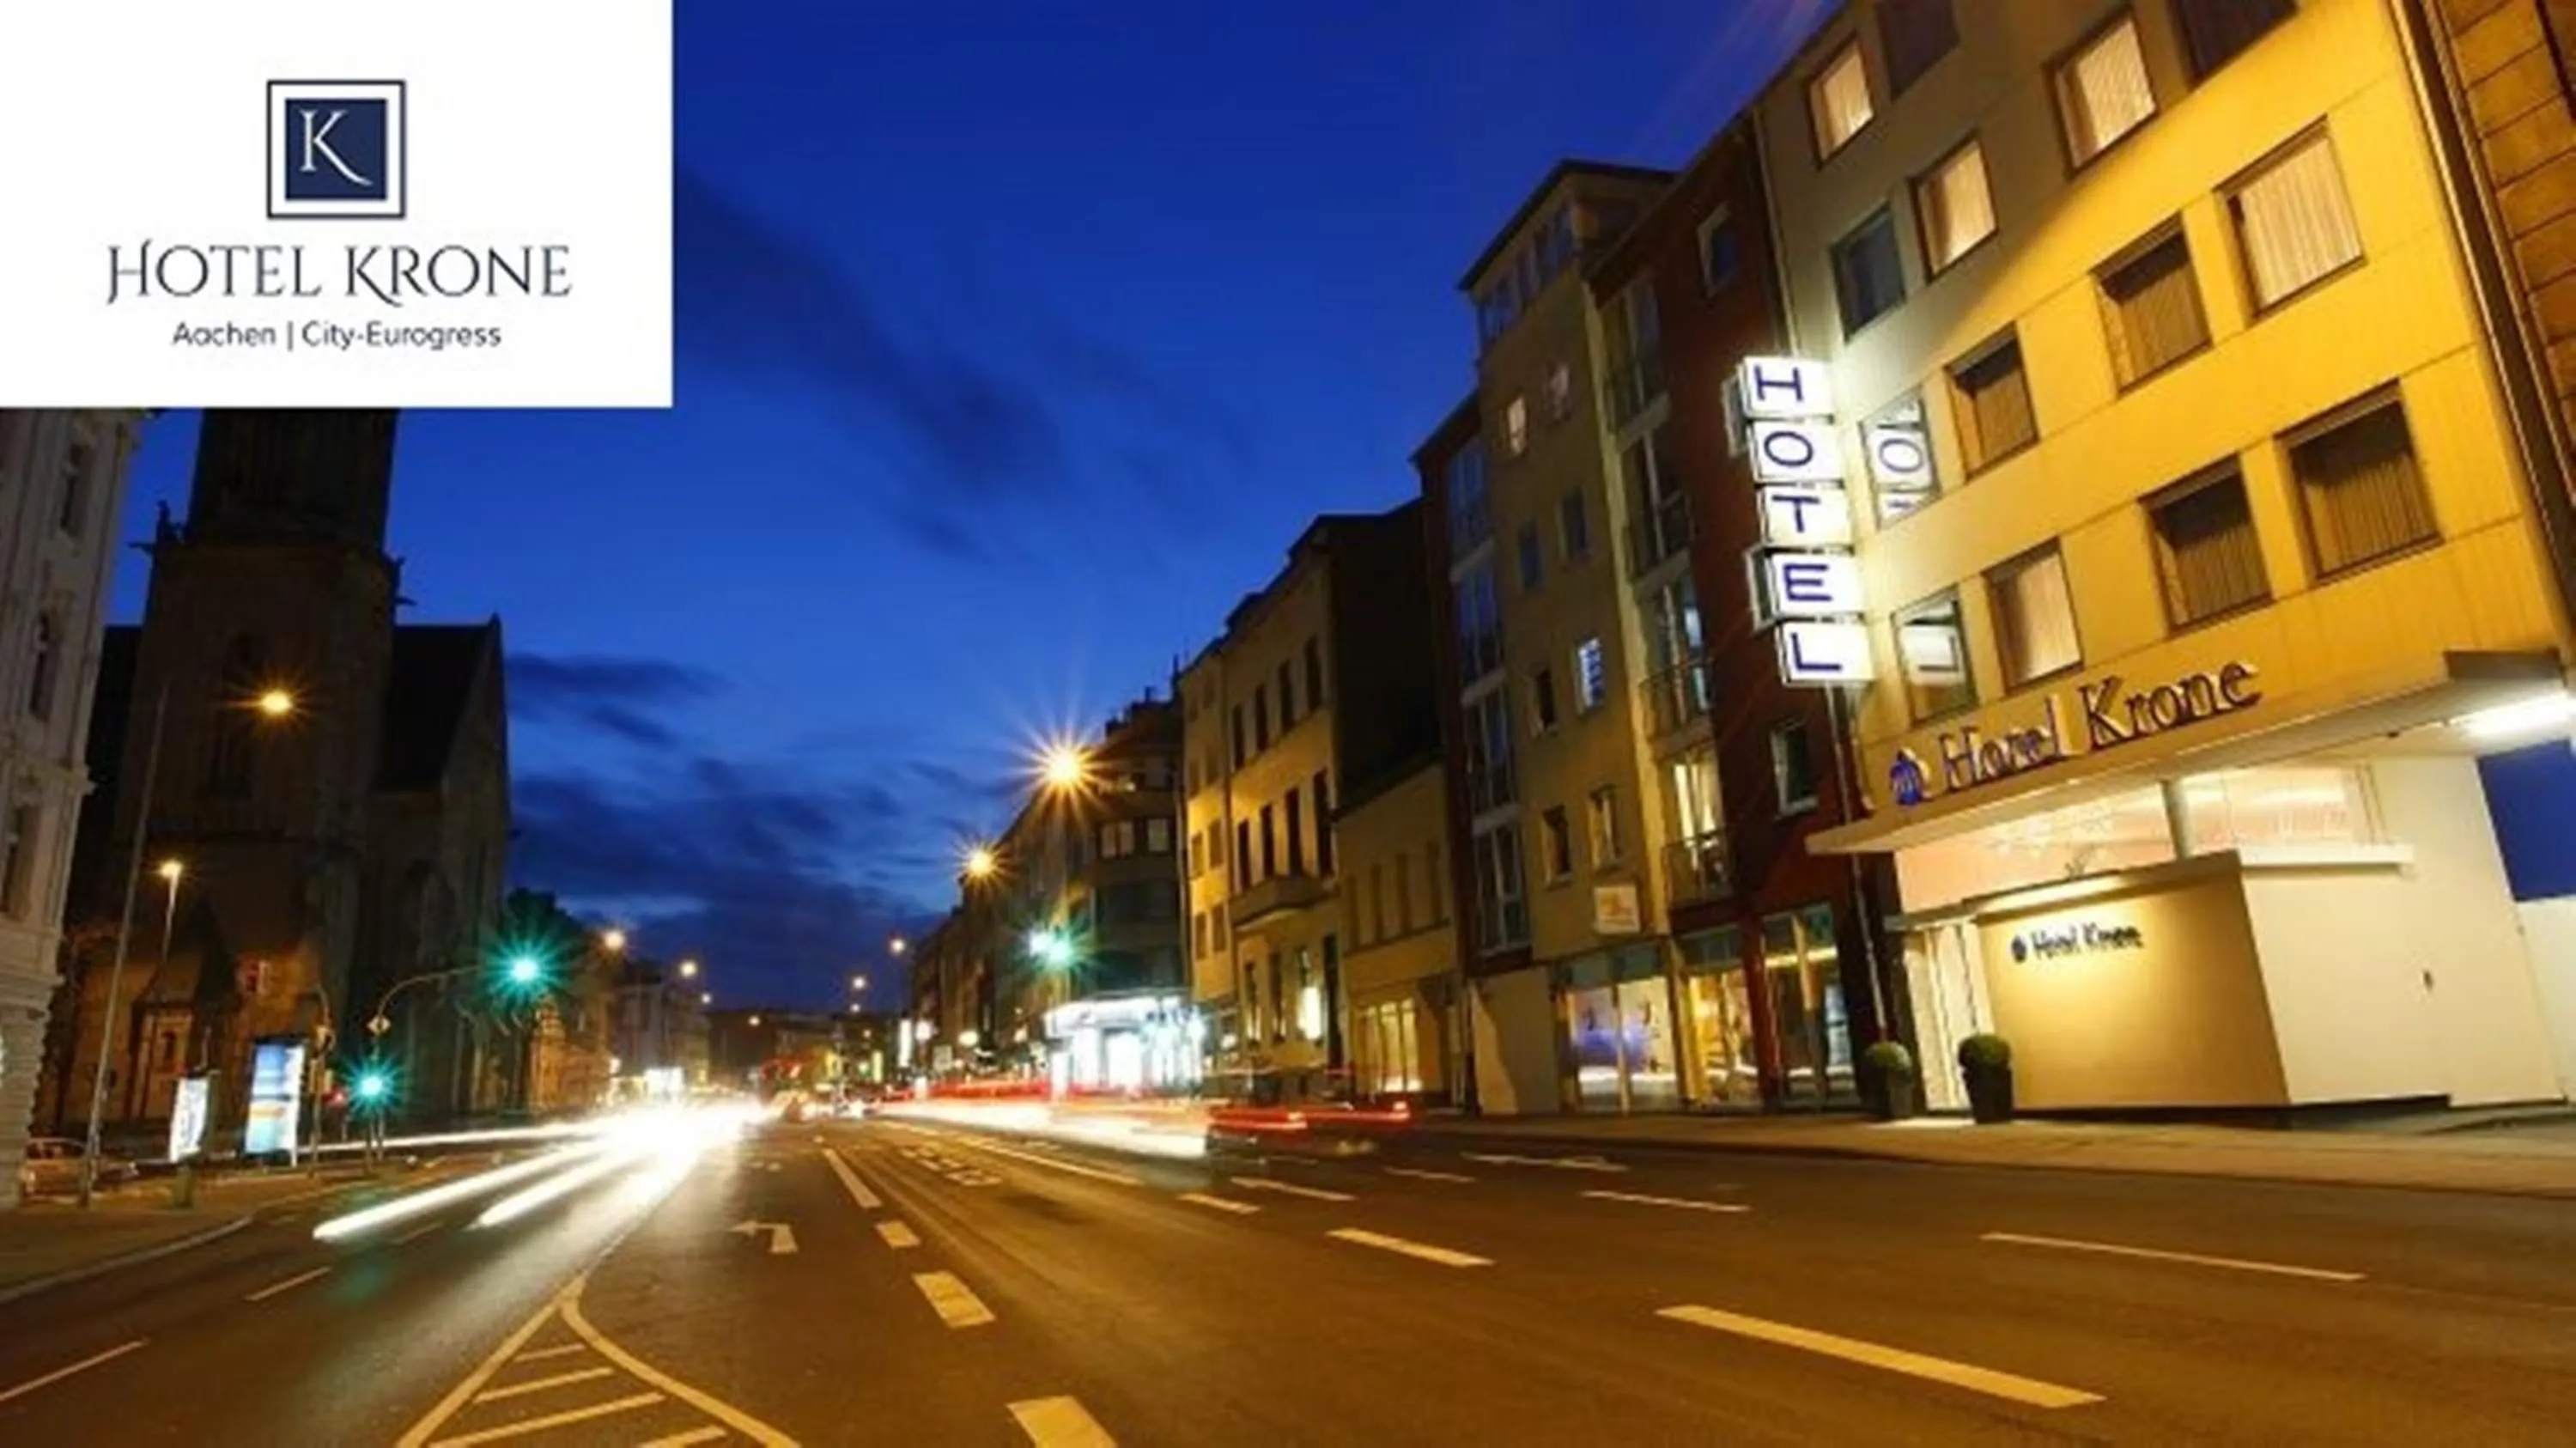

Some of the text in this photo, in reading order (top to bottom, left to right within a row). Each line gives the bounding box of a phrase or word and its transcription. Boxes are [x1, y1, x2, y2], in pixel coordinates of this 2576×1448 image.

[1753, 365, 1843, 672] HOTEL
[1938, 660, 2263, 792] Hotel Krone
